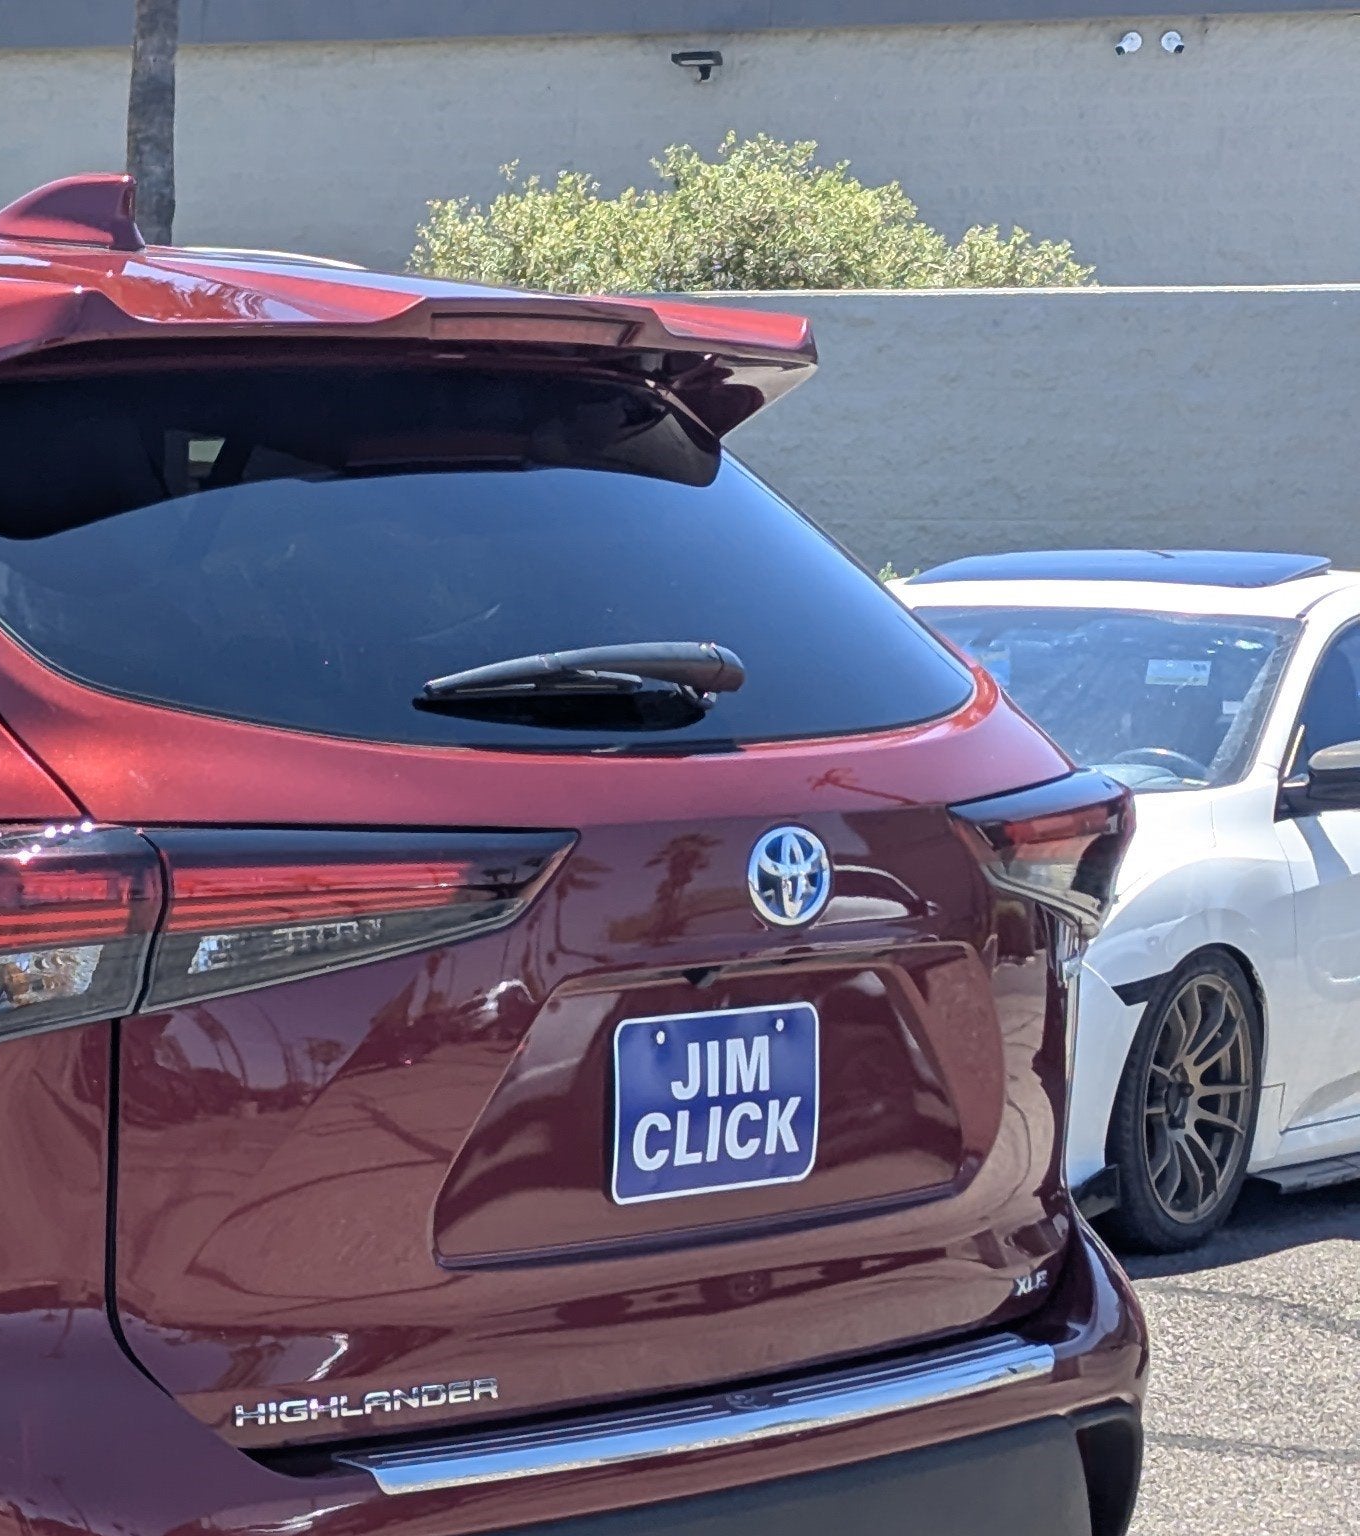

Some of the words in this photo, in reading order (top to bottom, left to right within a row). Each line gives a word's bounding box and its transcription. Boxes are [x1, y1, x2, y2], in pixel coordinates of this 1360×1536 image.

[671, 1035, 770, 1100] JIM
[632, 1096, 802, 1171] CLICK
[1015, 1270, 1048, 1297] XLE
[235, 1377, 499, 1427] HIGHLANDER
